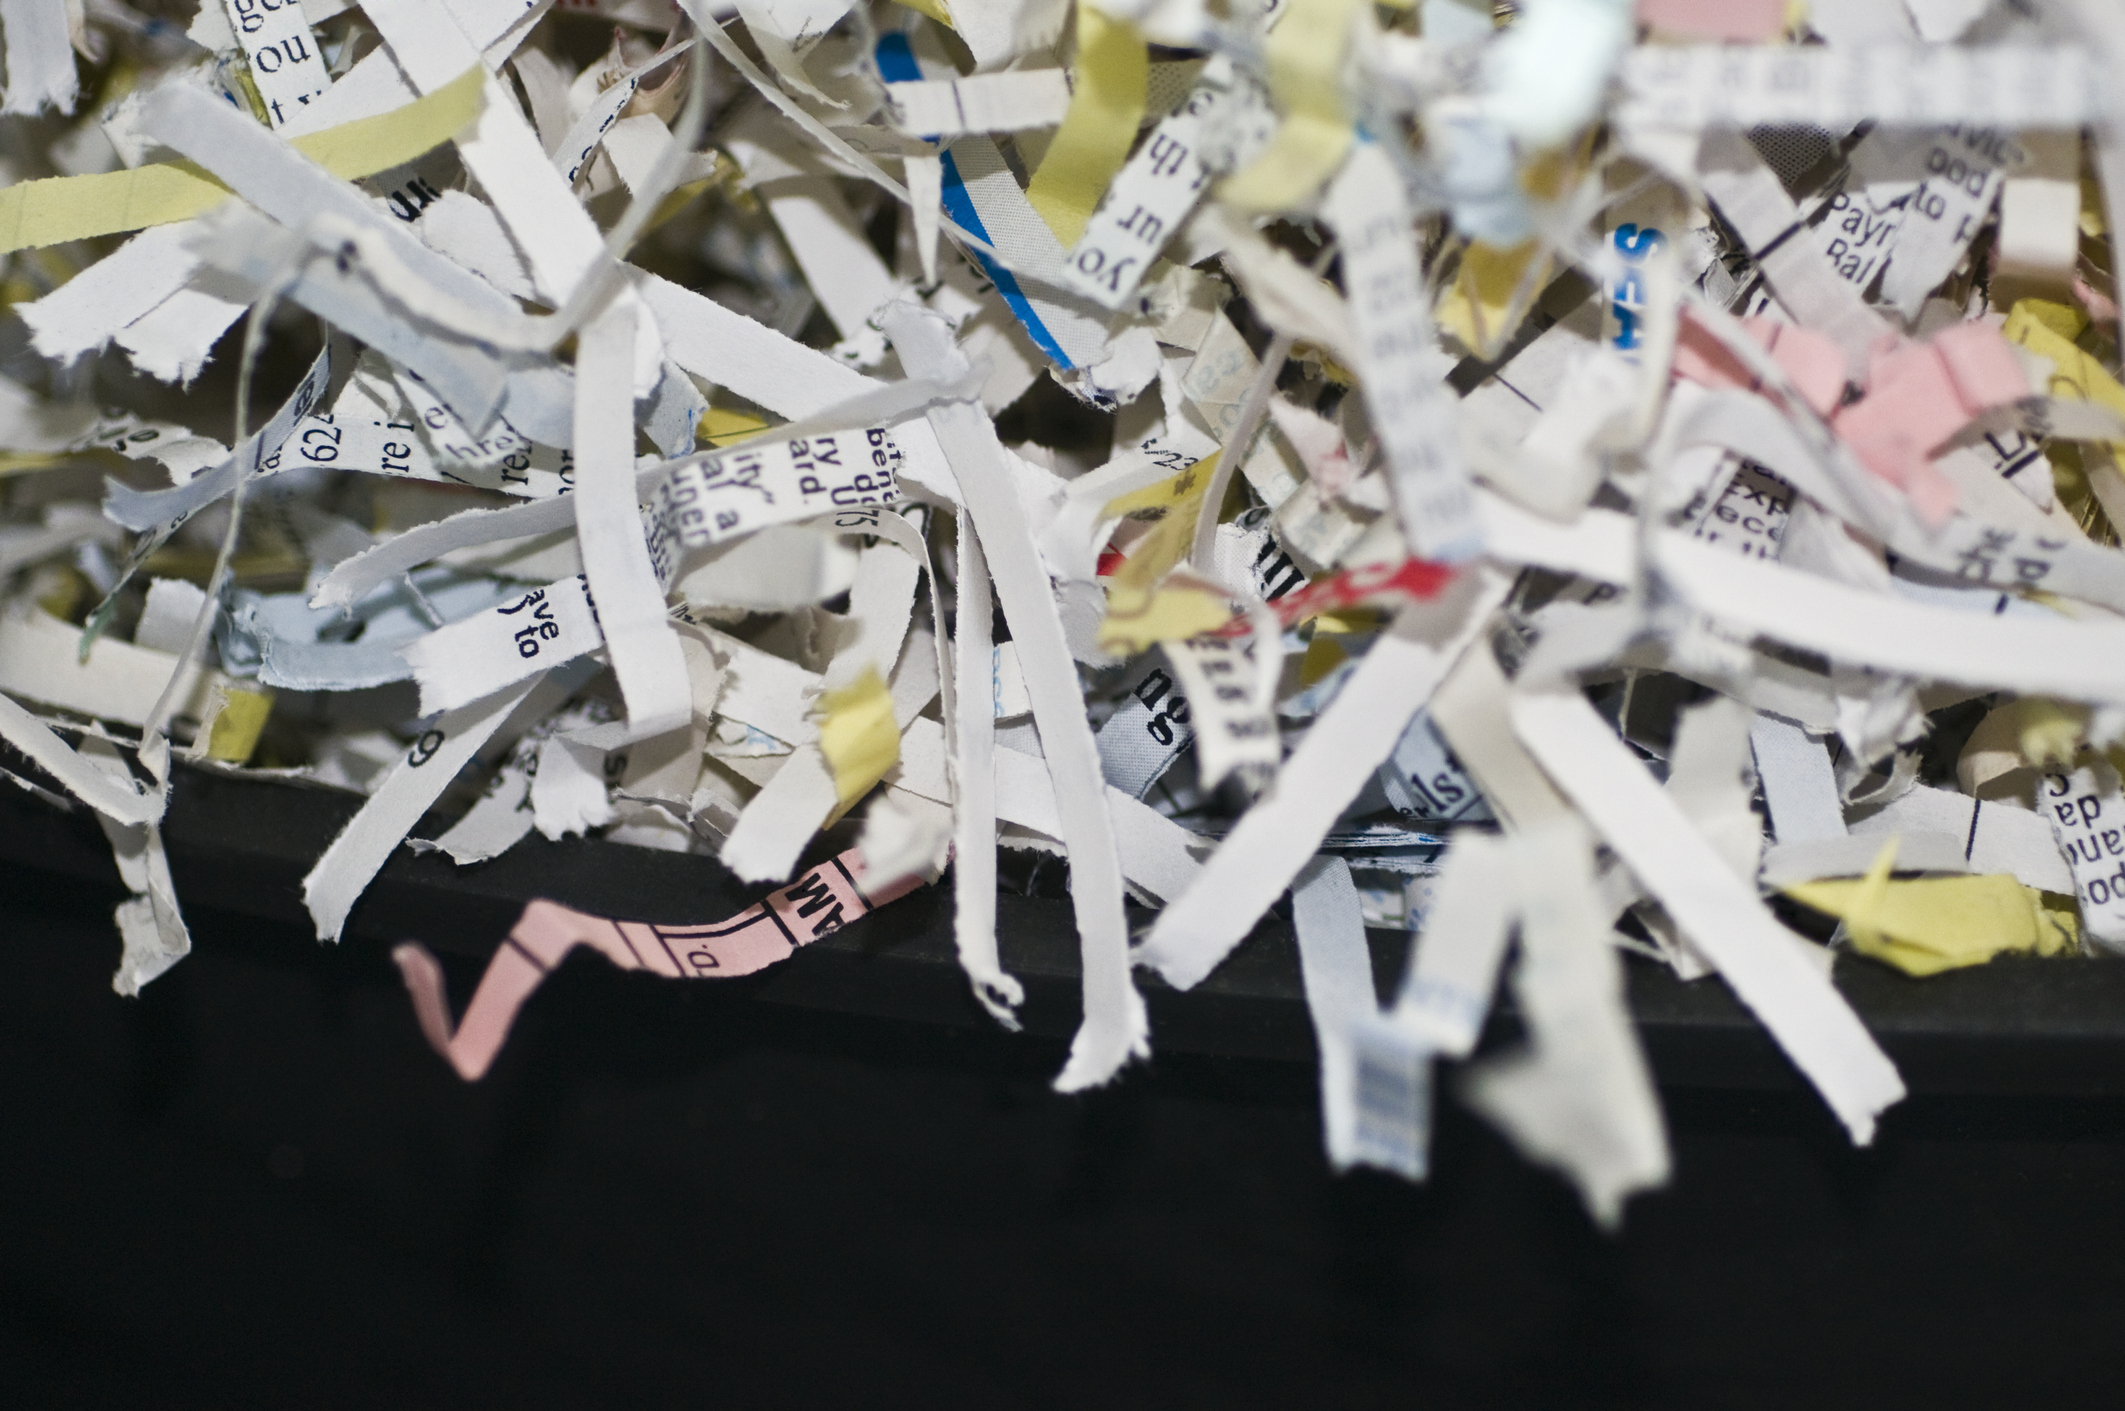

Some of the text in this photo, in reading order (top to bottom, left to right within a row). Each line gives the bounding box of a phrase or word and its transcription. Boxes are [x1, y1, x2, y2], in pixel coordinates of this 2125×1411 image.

[256, 35, 311, 73] ou
[1066, 246, 1137, 292] yo
[514, 624, 541, 659] to
